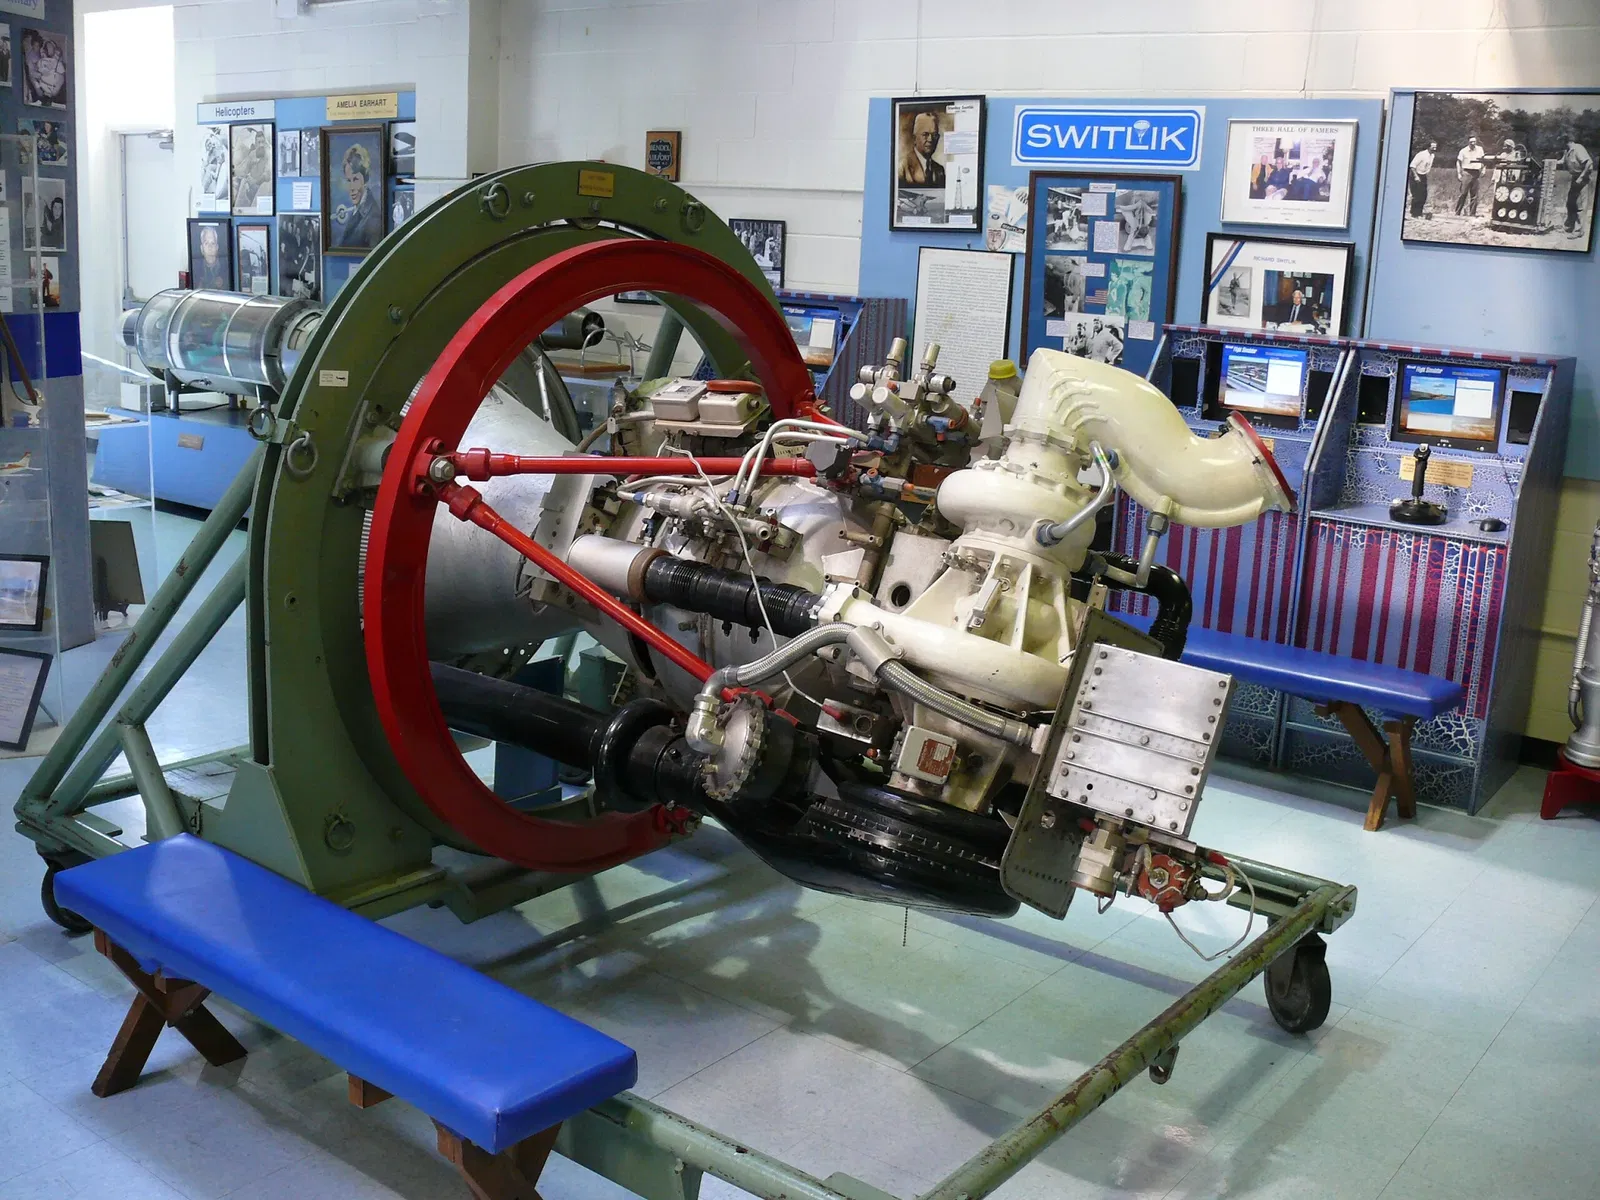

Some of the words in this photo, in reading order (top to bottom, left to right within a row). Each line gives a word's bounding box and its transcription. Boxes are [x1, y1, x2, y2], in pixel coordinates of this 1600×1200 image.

[336, 100, 357, 108] AMELIA
[359, 98, 387, 107] EARHART
[215, 107, 255, 118] Helicopters
[1026, 123, 1189, 151] SWITLIK
